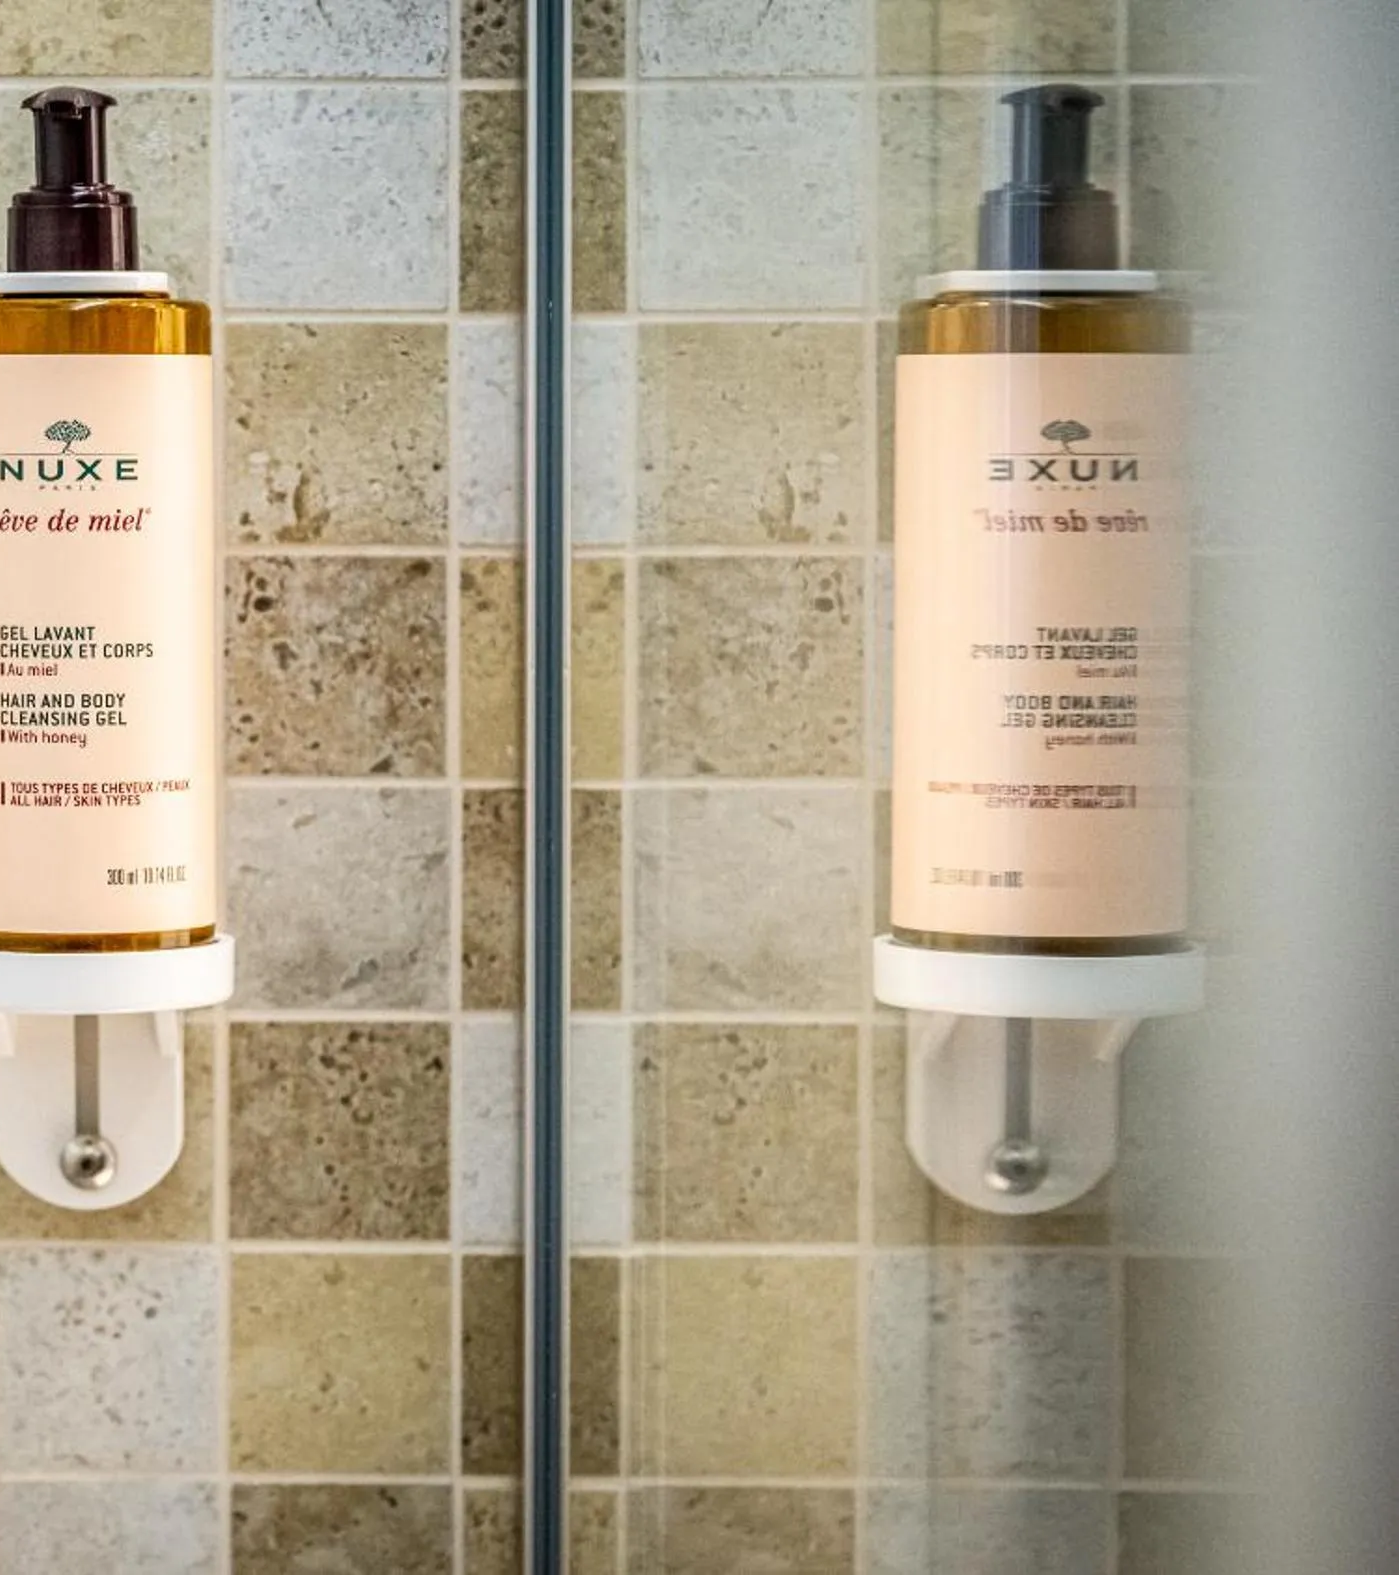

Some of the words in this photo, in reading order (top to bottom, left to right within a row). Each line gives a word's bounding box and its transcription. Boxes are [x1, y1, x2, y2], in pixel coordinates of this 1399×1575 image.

[0, 459, 138, 482] NUXE
[47, 508, 79, 532] de
[0, 626, 28, 641] GEL
[34, 626, 95, 641] LAVANT
[0, 644, 72, 659] CHEVEUX
[79, 644, 96, 659] ET
[103, 643, 153, 658] CORPS
[6, 663, 23, 676] Au
[27, 663, 58, 676] miel
[0, 694, 36, 708] HAIR
[40, 694, 75, 708] AND
[81, 693, 126, 708] BODY
[0, 711, 90, 726] CLEANSING
[96, 711, 127, 726] GEL
[8, 730, 38, 744] With
[41, 730, 88, 748] honey
[10, 783, 39, 794] TOUS
[42, 783, 79, 794] TYPES
[83, 783, 98, 794] DE
[101, 781, 153, 794] CHEVEUX
[10, 796, 31, 807] ALL
[34, 796, 62, 807] HAIR
[74, 796, 102, 807] SKIN
[106, 795, 141, 807] TYPES
